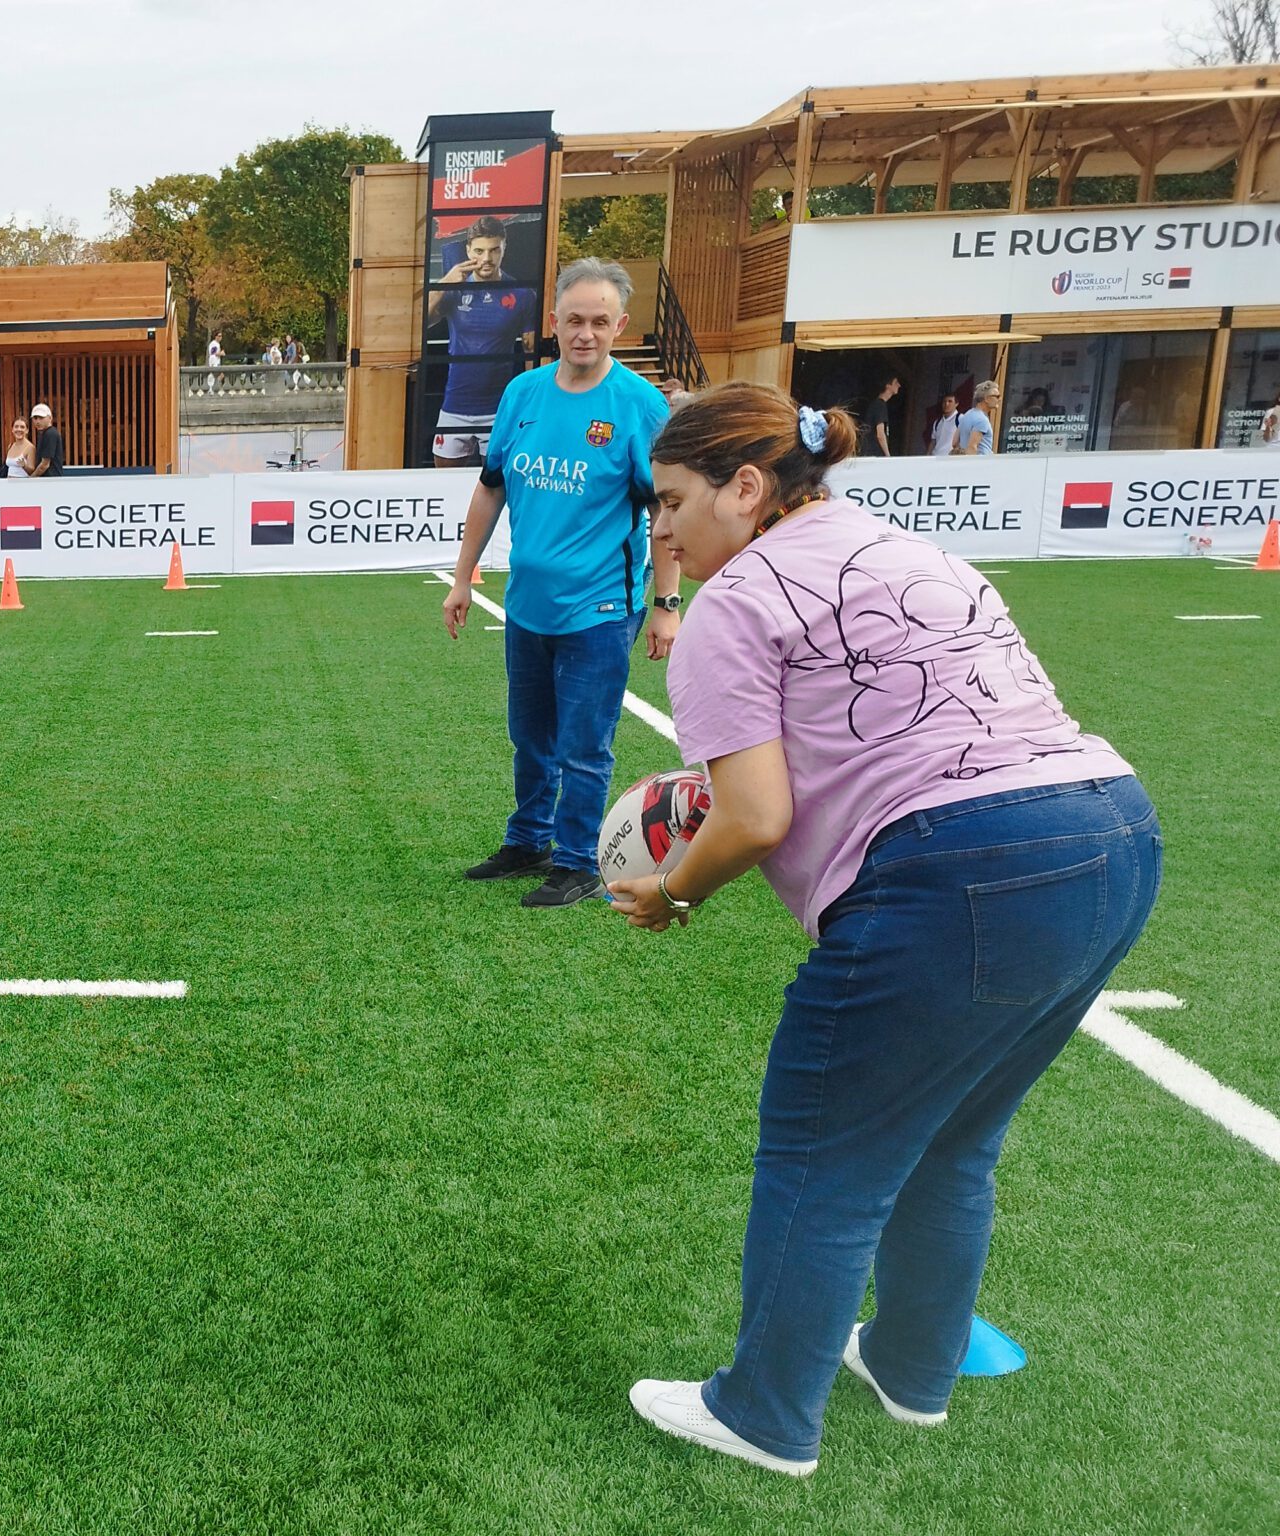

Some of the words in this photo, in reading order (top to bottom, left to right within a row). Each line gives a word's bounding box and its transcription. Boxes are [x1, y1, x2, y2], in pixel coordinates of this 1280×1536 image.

[446, 150, 507, 168] ENSEMBLE,
[445, 167, 475, 184] TOUT
[444, 183, 458, 199] SE
[460, 182, 491, 198] JOUE
[952, 231, 997, 258] LE
[1008, 225, 1146, 256] RUGBY
[1154, 219, 1280, 251] STUDI
[1075, 277, 1105, 286] WORLD
[1106, 277, 1123, 285] CUP
[1141, 272, 1165, 286] SG
[1010, 415, 1065, 423] COMMENTEZ
[1226, 419, 1261, 427] ACTION
[1228, 410, 1266, 418] COMMEN
[1043, 424, 1089, 432] MYTHIQUE
[513, 453, 588, 482] QATAR
[525, 475, 585, 496] AIRWAYS
[1127, 479, 1280, 502] SOCIETE
[845, 485, 991, 508] SOCIETE
[54, 503, 186, 524] SOCIETE
[308, 498, 445, 519] SOCIETE
[871, 510, 1022, 532] NERALE
[54, 527, 216, 549] GENERALE
[600, 819, 633, 874] TRAINING
[613, 852, 627, 870] T3
